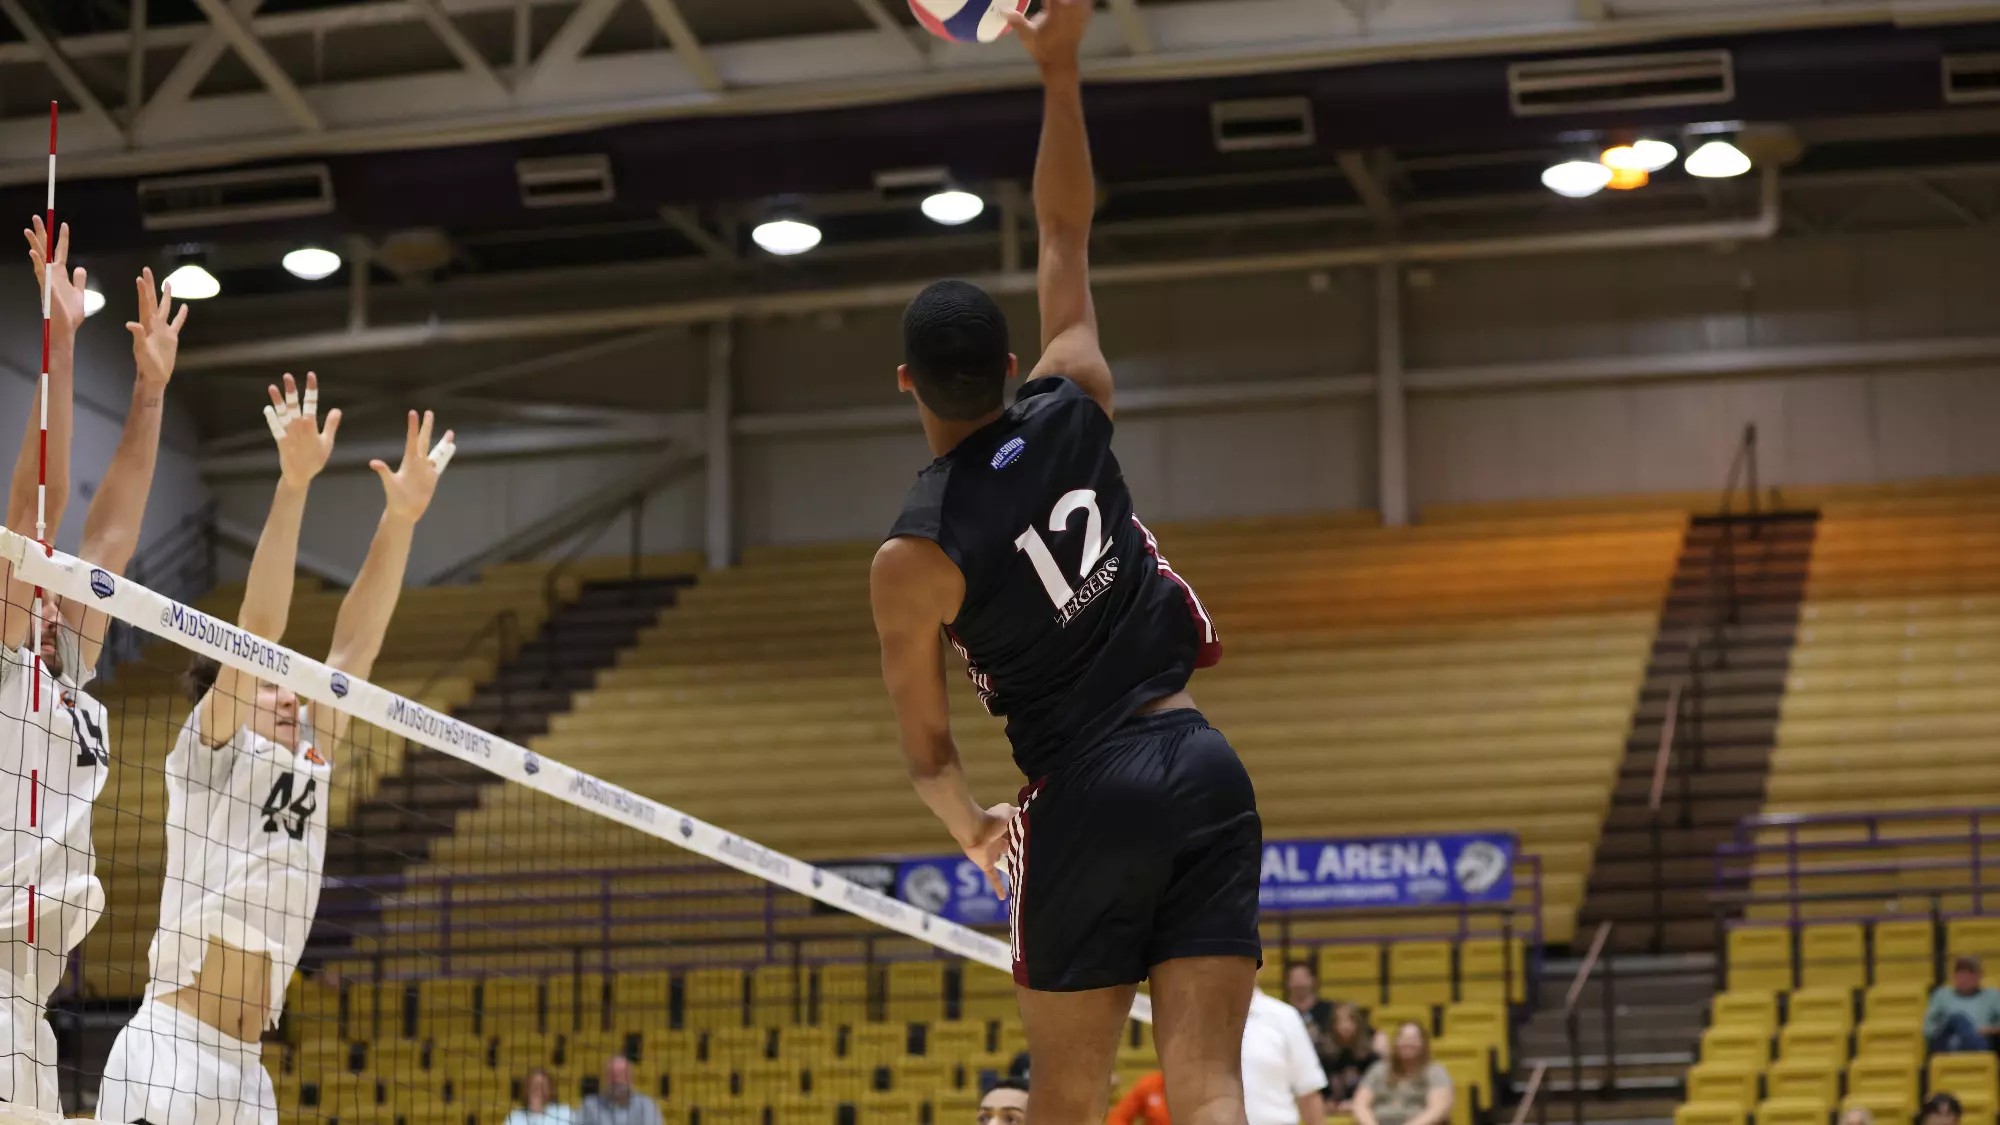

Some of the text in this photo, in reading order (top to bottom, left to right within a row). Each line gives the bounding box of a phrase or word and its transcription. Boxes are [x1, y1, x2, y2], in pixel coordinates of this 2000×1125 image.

[991, 437, 1026, 469] MID-SOUTH
[1014, 489, 1114, 610] 12
[1314, 840, 1448, 881] ARENA
